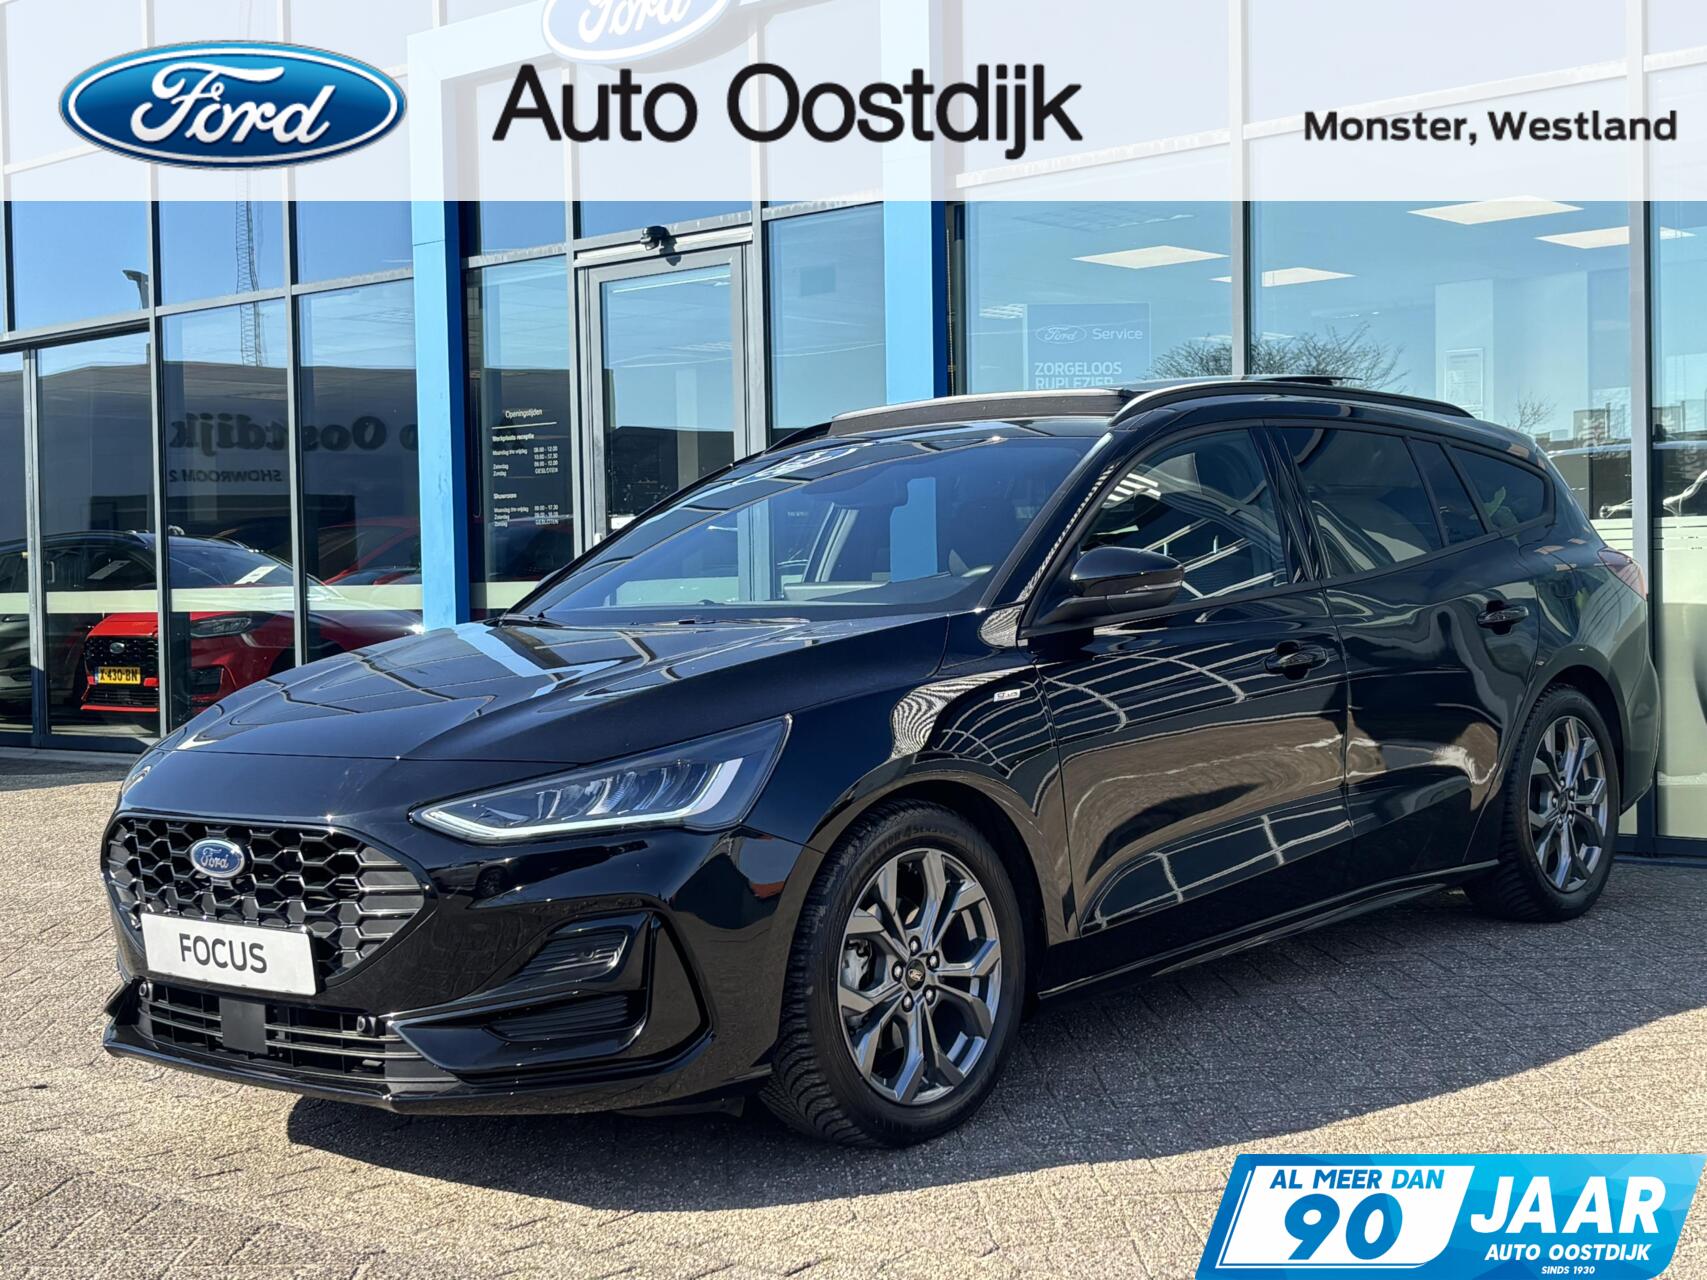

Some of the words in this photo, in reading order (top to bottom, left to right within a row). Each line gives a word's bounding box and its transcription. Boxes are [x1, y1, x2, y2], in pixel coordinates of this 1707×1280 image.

[1092, 327, 1144, 340] Service
[1034, 361, 1122, 376] ZORGELOOS
[200, 847, 230, 869] Ford
[179, 932, 268, 974] FOCUS
